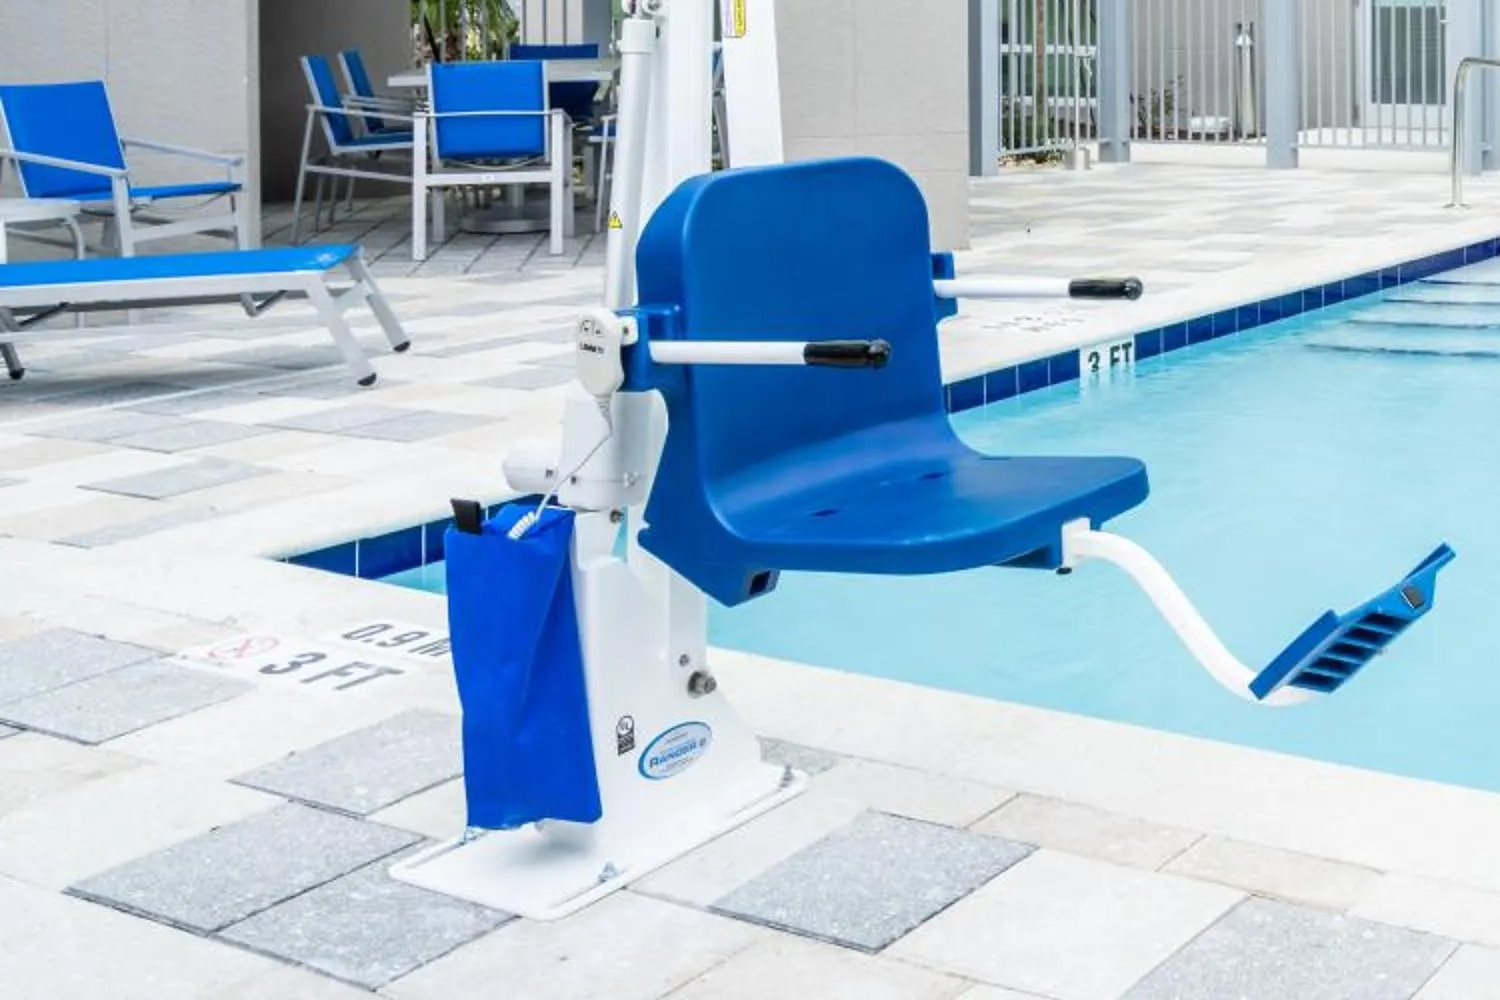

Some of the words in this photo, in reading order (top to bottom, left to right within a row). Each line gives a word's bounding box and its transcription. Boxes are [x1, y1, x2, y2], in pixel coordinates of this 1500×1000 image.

[1087, 351, 1100, 373] 3
[1109, 341, 1133, 366] FT
[341, 623, 431, 648] 0.9
[258, 651, 328, 675] 3
[299, 660, 406, 691] FT
